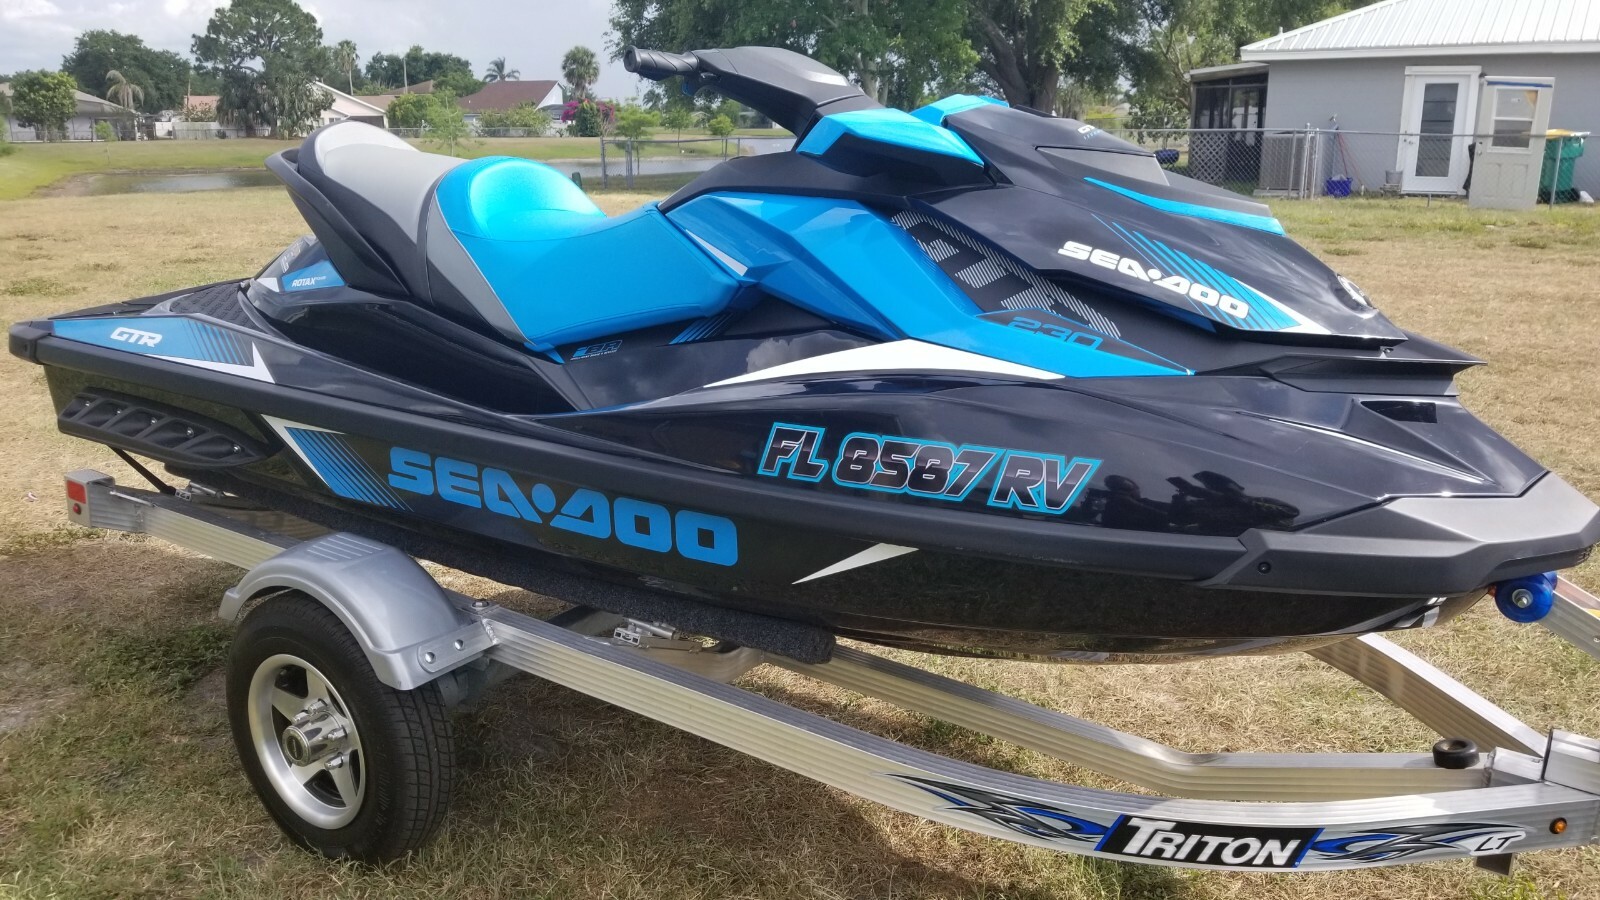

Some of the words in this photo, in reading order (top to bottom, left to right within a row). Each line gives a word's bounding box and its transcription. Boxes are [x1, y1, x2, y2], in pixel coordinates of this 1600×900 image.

[292, 278, 316, 288] ROTAX
[110, 326, 163, 348] GTR
[1007, 316, 1103, 350] 230
[757, 422, 828, 484] FL
[831, 431, 1002, 502] 8587
[987, 449, 1102, 515] RV
[1122, 817, 1302, 866] TRITON
[1474, 836, 1522, 851] LT
